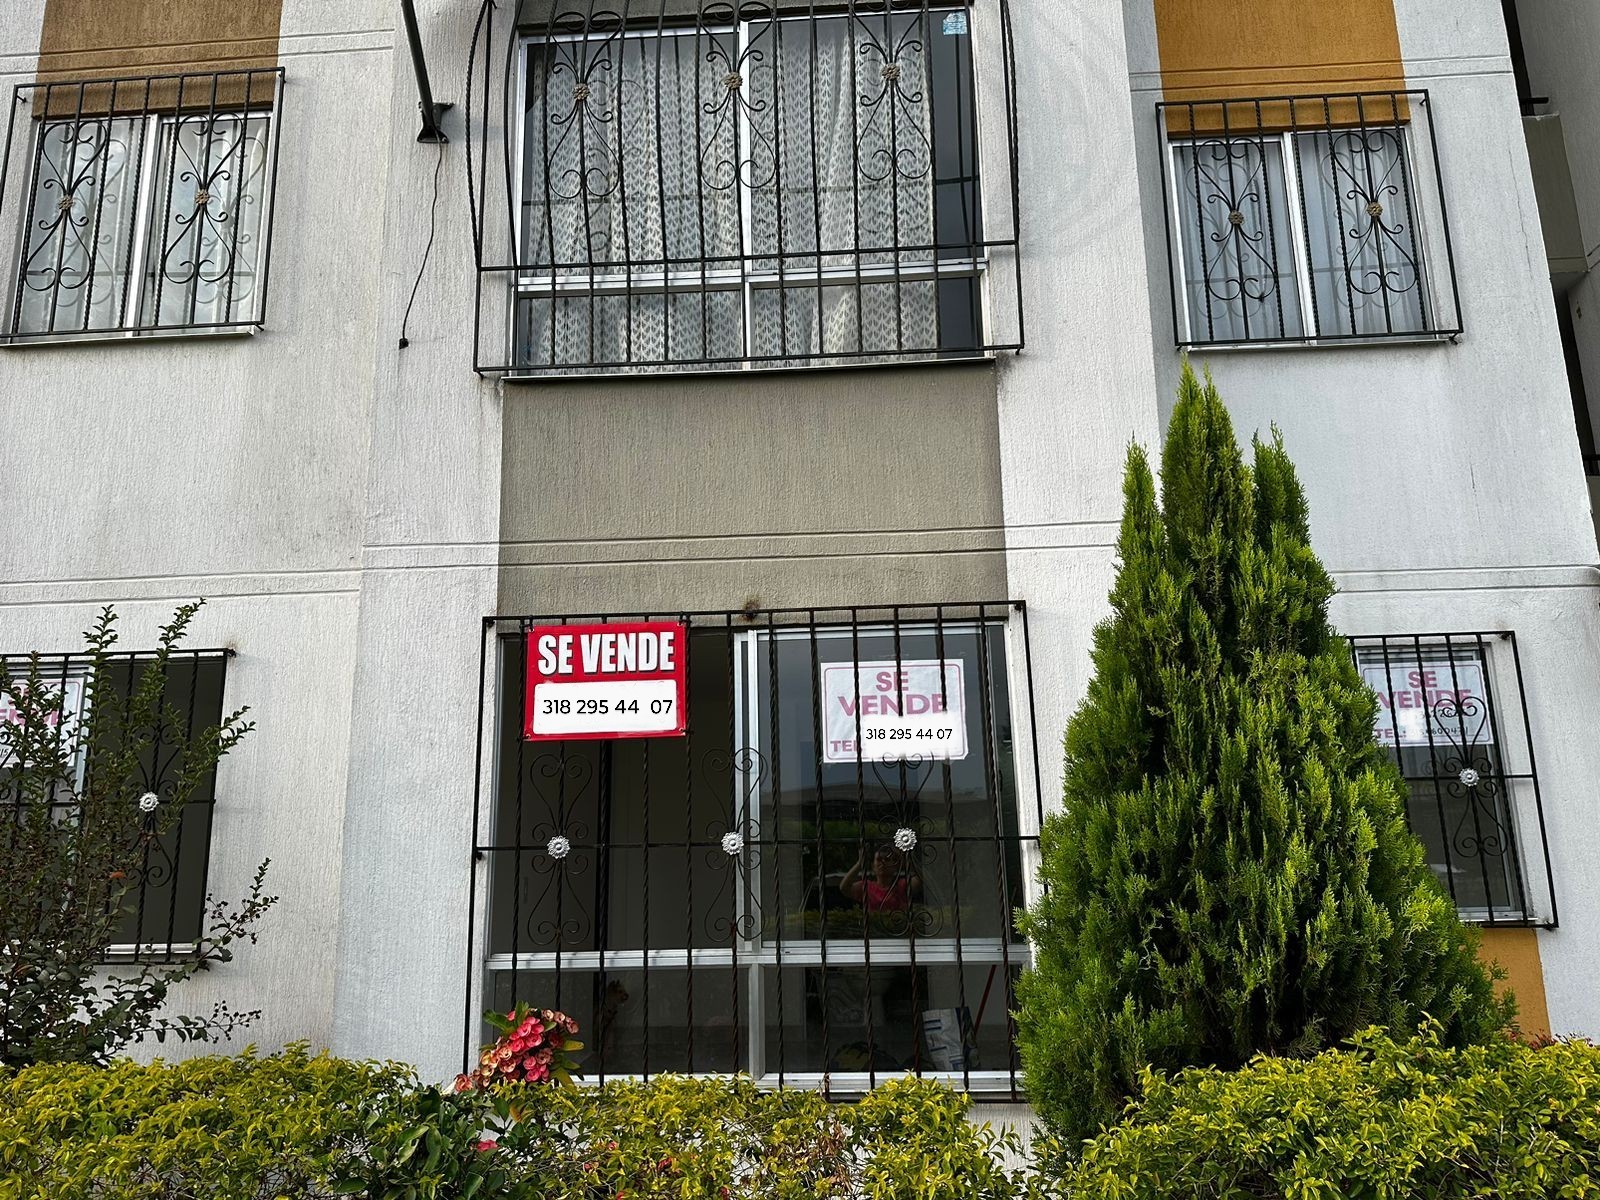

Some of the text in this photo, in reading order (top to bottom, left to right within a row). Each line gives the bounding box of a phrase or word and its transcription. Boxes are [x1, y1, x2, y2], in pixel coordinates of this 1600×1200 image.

[538, 631, 675, 675] SE VENDE
[875, 671, 909, 692] SE
[1408, 670, 1438, 689] SE
[1377, 689, 1473, 709] VENDE
